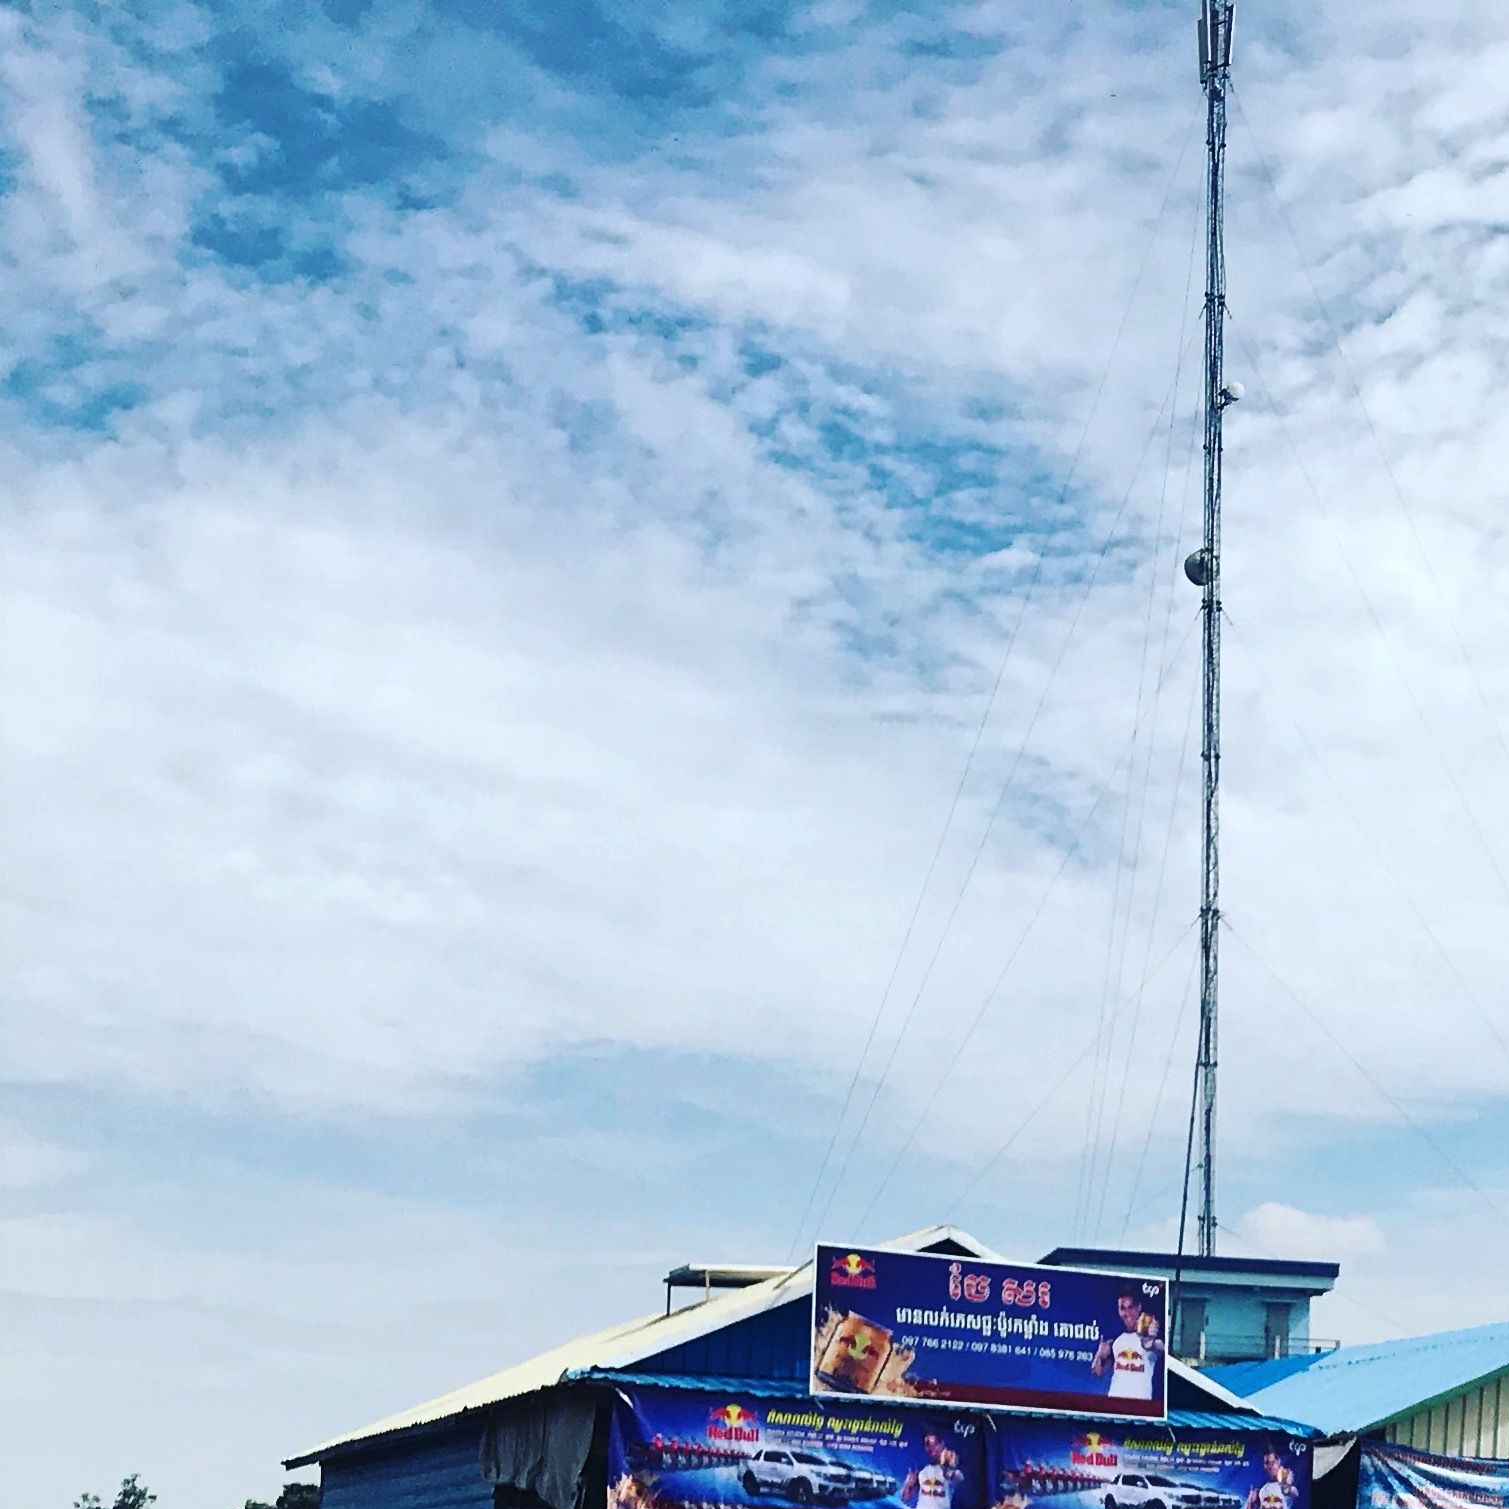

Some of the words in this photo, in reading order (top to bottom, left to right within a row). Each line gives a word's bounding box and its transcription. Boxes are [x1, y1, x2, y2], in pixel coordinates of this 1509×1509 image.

[708, 1424, 733, 1441] Red
[734, 1426, 760, 1443] Bull
[1072, 1451, 1094, 1465] Red
